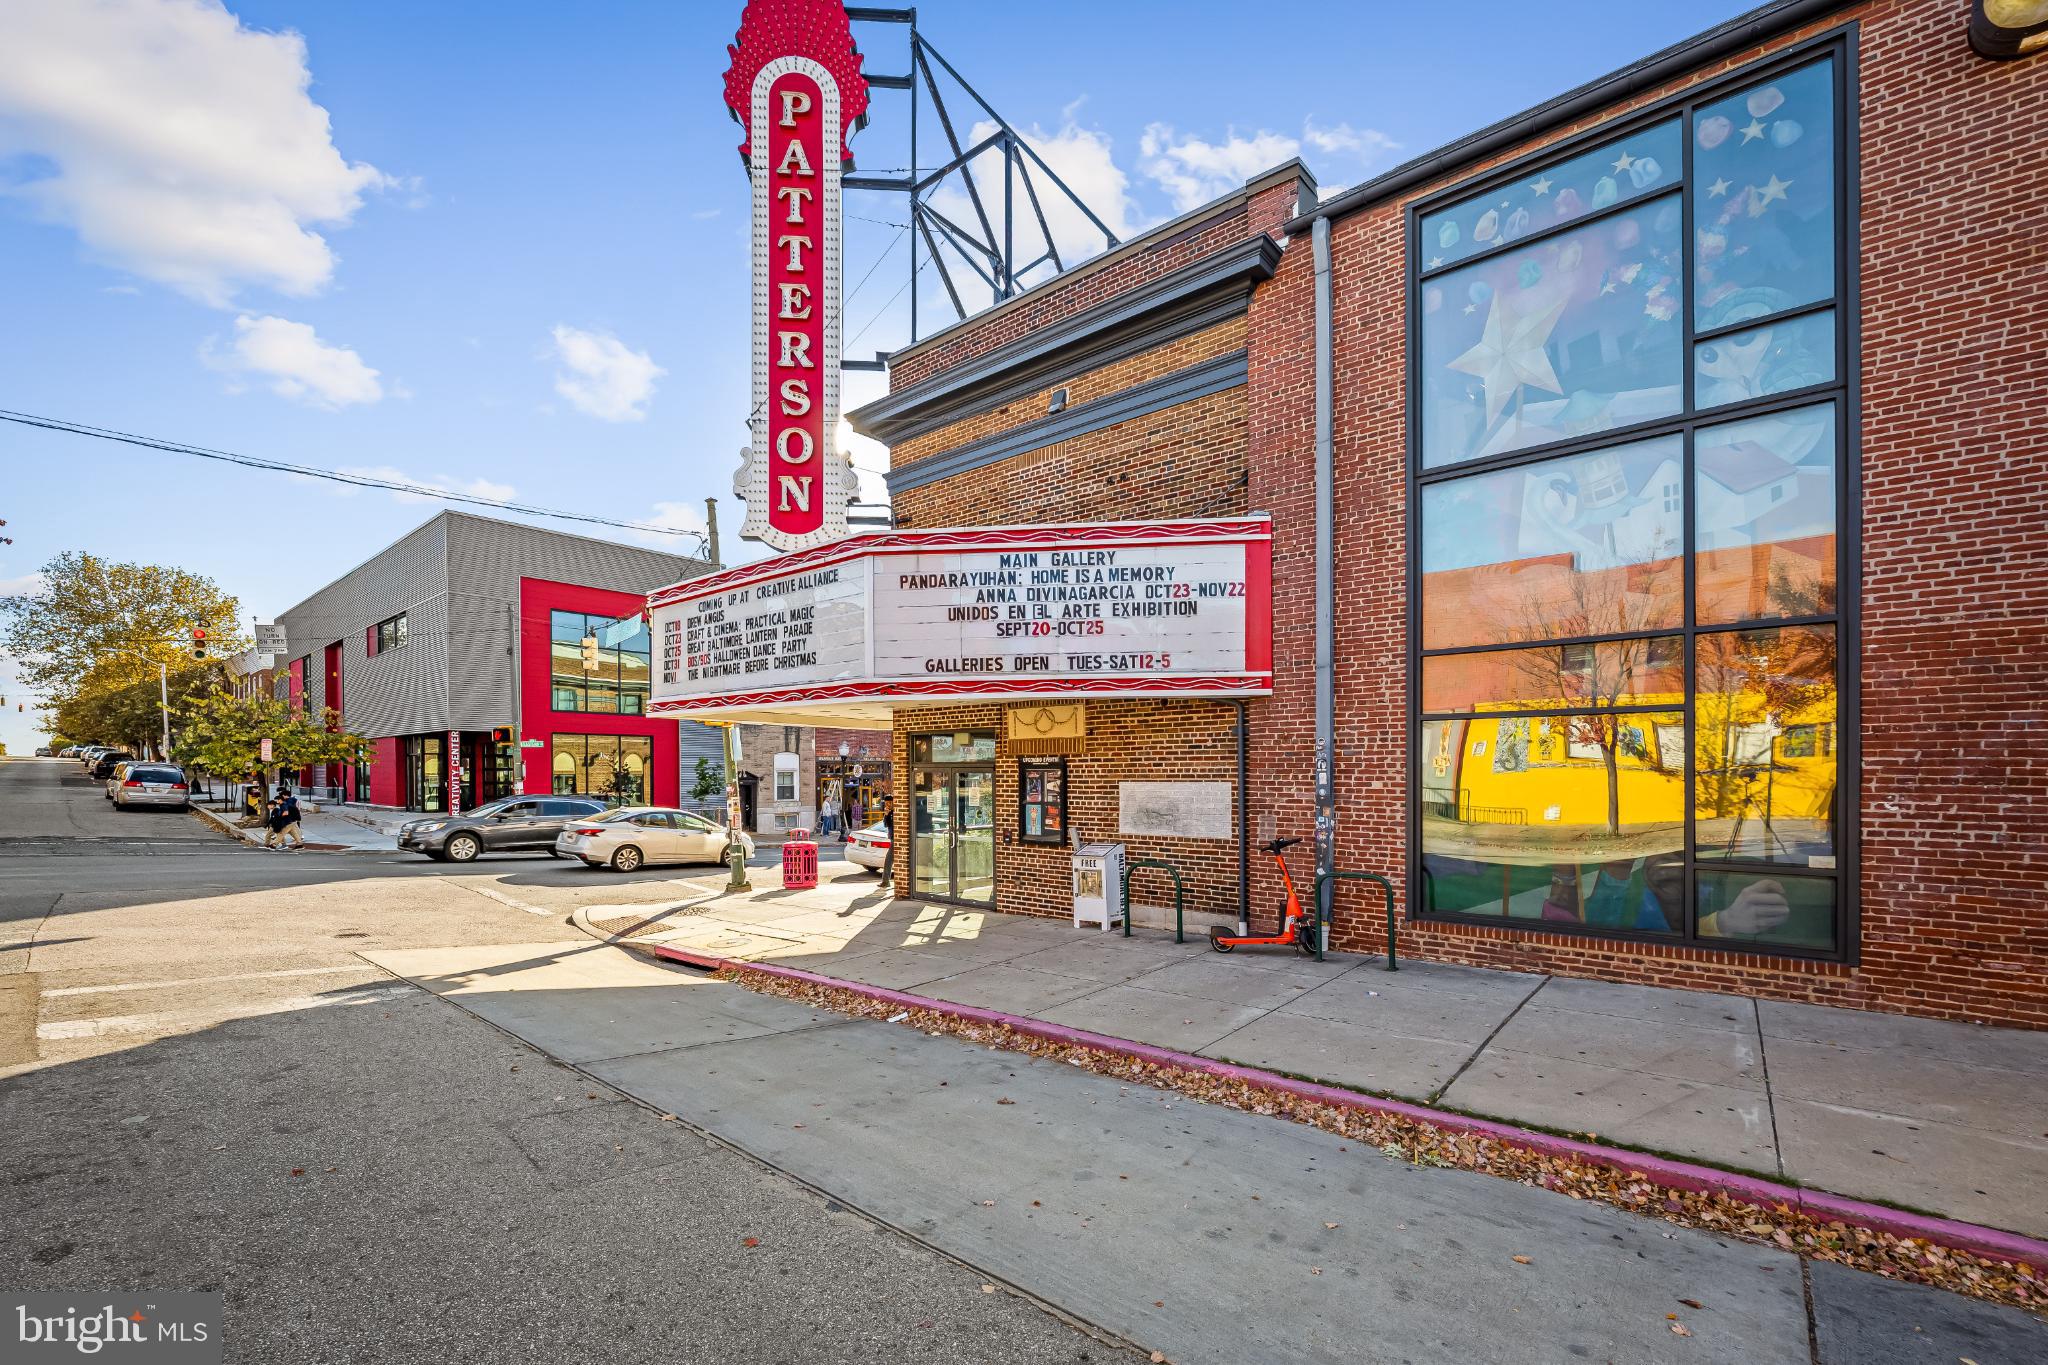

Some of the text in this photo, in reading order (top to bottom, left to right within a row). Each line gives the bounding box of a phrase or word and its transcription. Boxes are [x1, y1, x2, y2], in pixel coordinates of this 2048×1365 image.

[776, 90, 815, 512] PATTERSON
[1000, 551, 1116, 568] MAIN GALLERY
[900, 567, 1175, 588] PANDARAYUHAN: HOME IS A MEMORY
[699, 569, 838, 612] COMING UP AT CREATIVE ALLIANCE
[976, 582, 1244, 603] ANNA DIVINAGARCIA OCT23-NOV22
[687, 616, 702, 629] DREW
[704, 610, 724, 624] ANGUS
[948, 606, 998, 621] UNIDOS
[1009, 604, 1026, 619] EN
[1062, 603, 1100, 618] ARTE
[1113, 601, 1197, 616] EXHIBITION
[665, 606, 814, 645] OCT23 CRAFT & CINEMA: PRACTICAL MAGIC
[996, 621, 1104, 636] SEPT20-OCT25
[664, 622, 812, 658] OCT25 GREAT BALTIMORE LANTERN PARADE
[664, 659, 680, 670] OCT31
[714, 646, 750, 664] HALLOWEEN
[753, 643, 775, 657] DANCE
[782, 638, 806, 654] PARTY
[688, 669, 698, 680] THE
[703, 662, 740, 678] NIGHTMARE
[745, 658, 768, 673] BEFORE
[774, 652, 816, 669] CHRISTMAS
[926, 654, 1171, 673] GALLERIES OPEN TUES-SAT12-5
[451, 730, 460, 816] REATIVITY CENTER
